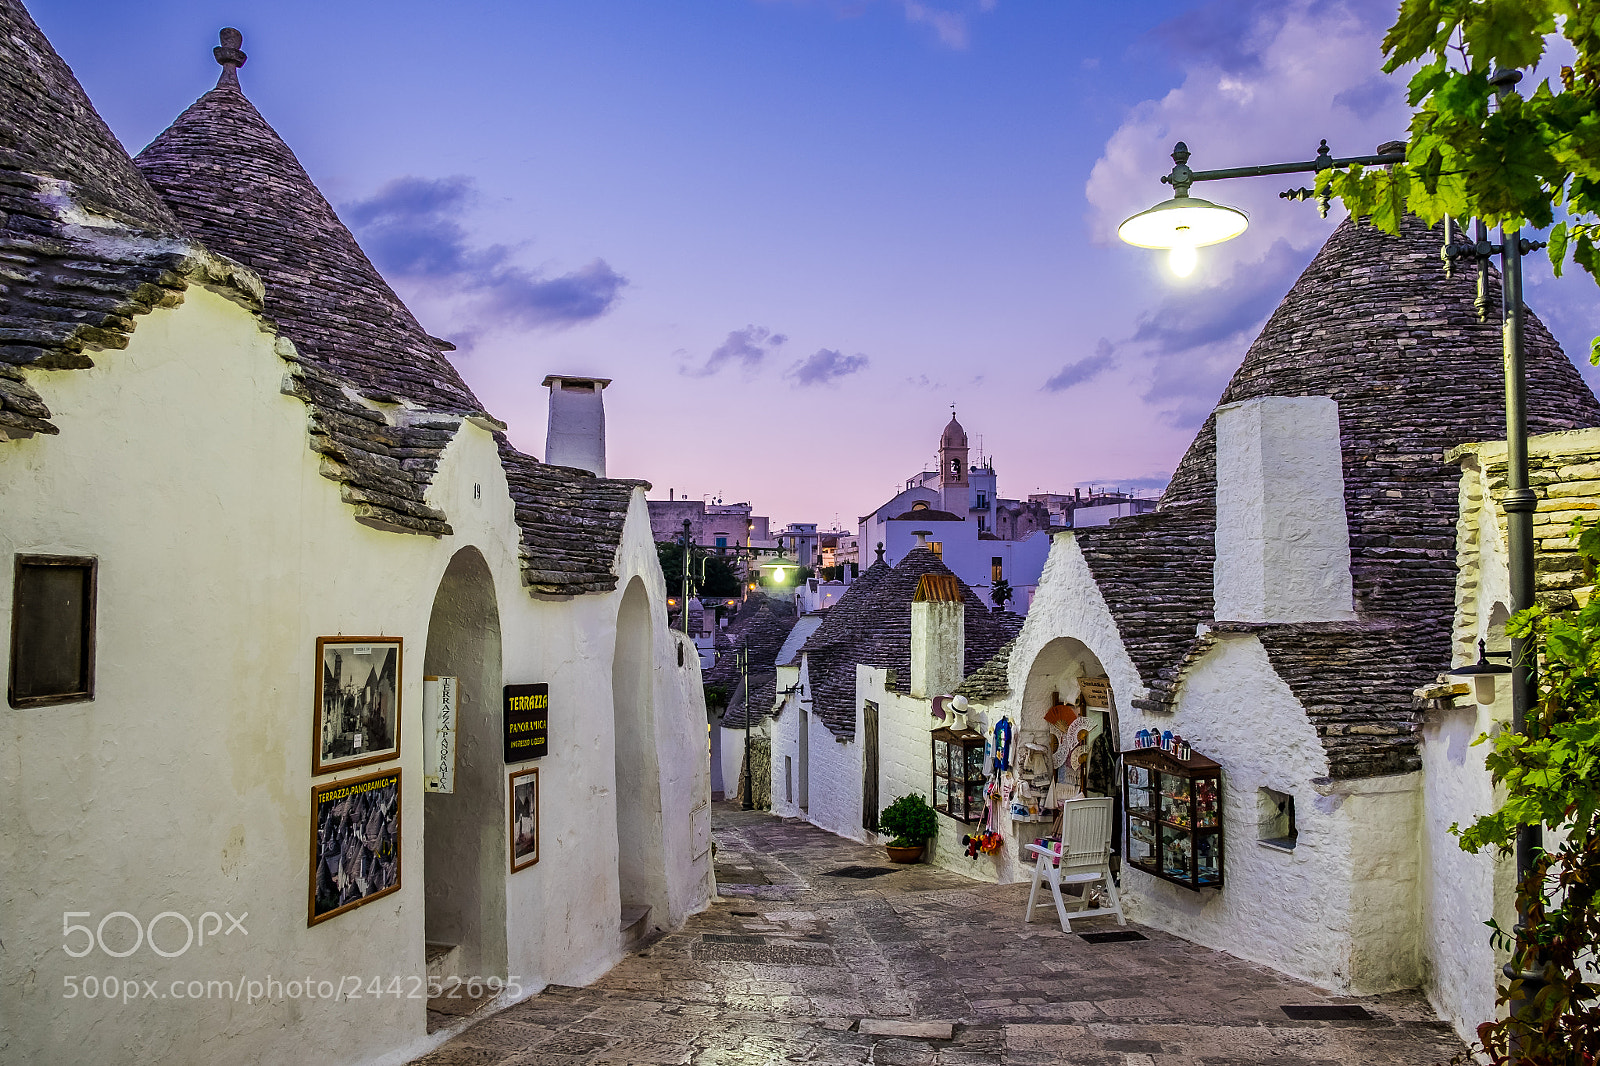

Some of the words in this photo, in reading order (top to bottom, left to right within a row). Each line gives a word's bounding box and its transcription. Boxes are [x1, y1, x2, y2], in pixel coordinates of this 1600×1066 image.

[473, 482, 481, 500] 19
[440, 677, 451, 731] TERRAZZA
[509, 694, 548, 711] TERRAZZA
[509, 720, 547, 734] PANORAMICA
[439, 732, 449, 790] PANORAMICA
[318, 786, 350, 804] TERRAZZA
[350, 778, 389, 796] PANORAMICA
